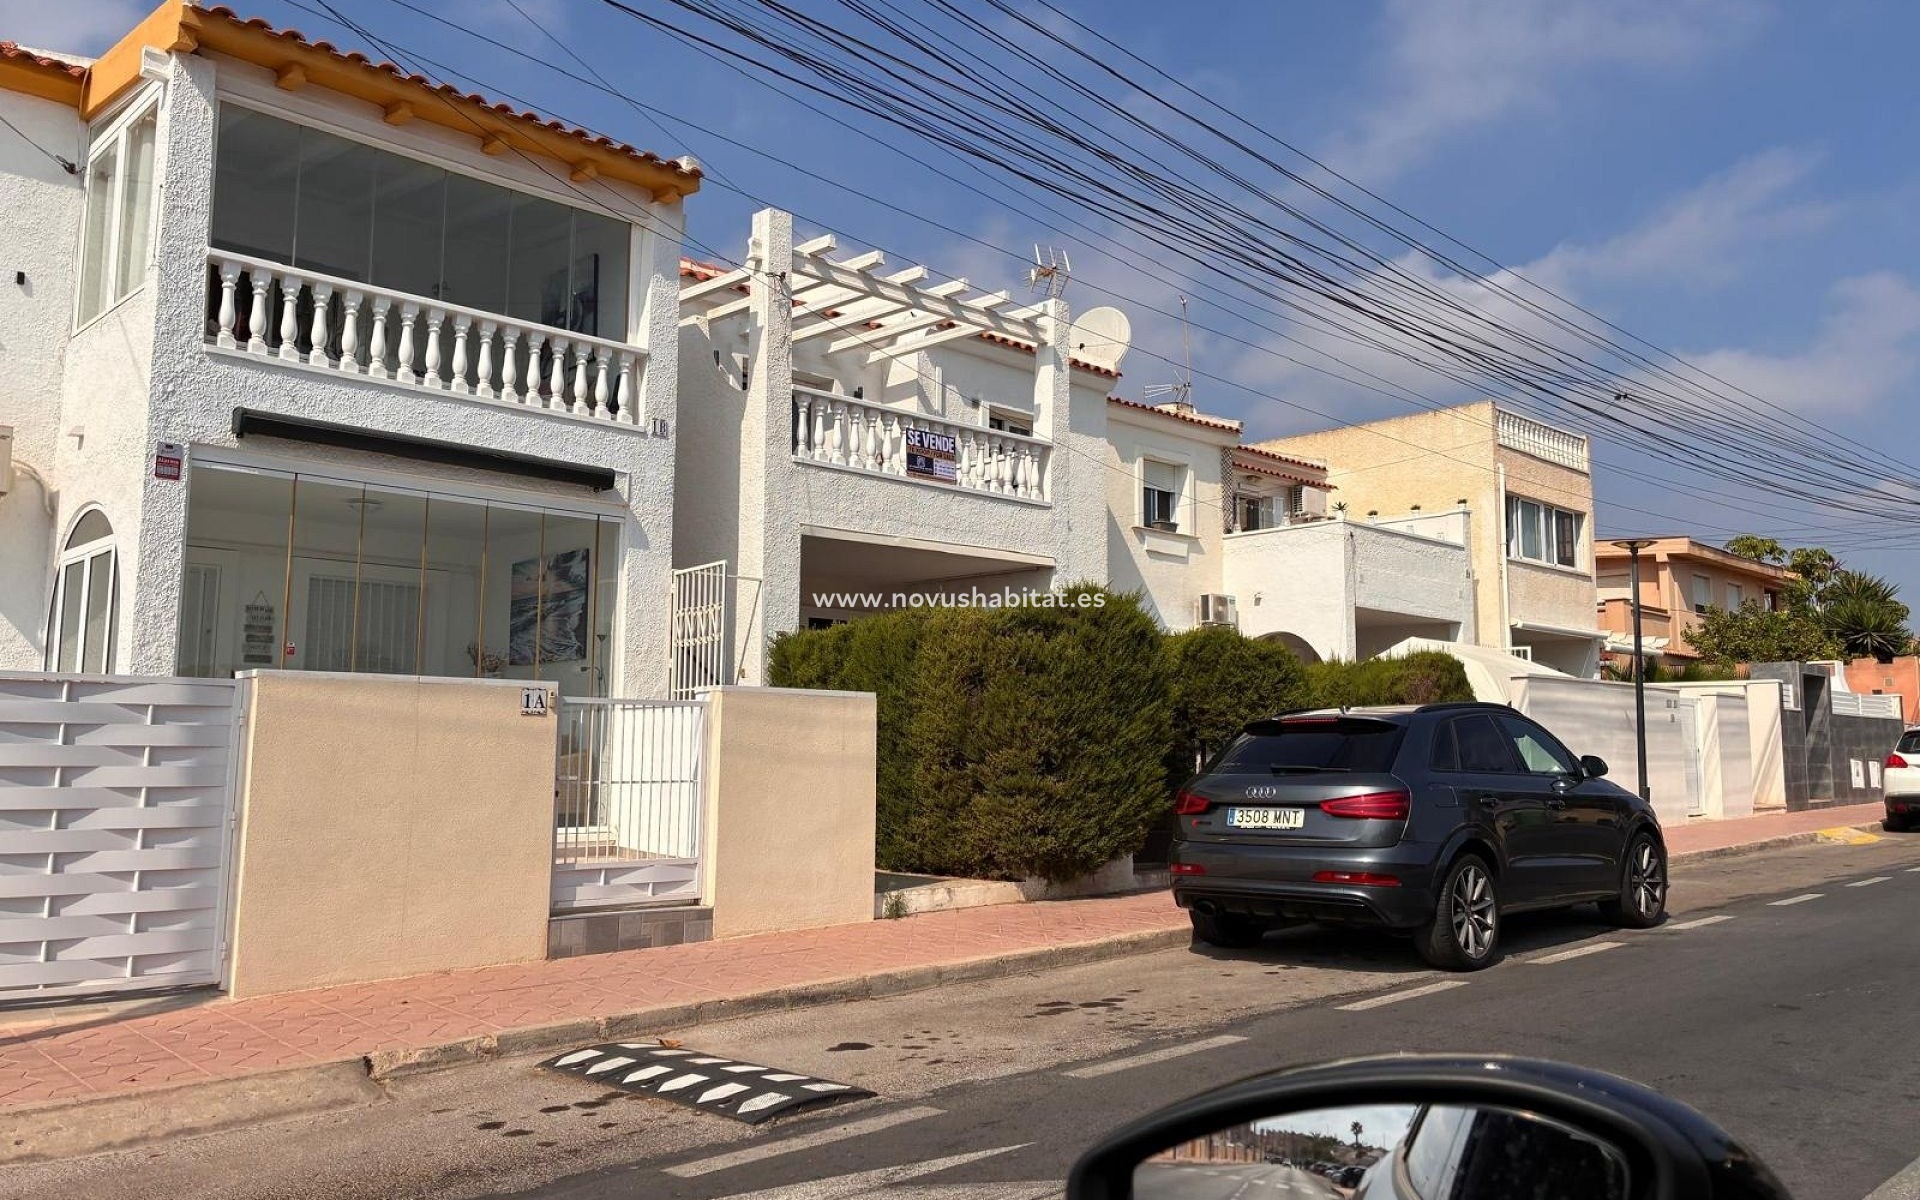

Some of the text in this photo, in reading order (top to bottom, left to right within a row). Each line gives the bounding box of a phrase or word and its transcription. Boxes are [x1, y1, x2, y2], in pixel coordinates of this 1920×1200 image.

[907, 430, 955, 454] SE VENDE
[524, 693, 546, 709] 1A
[1236, 809, 1300, 825] 3508 MNT
